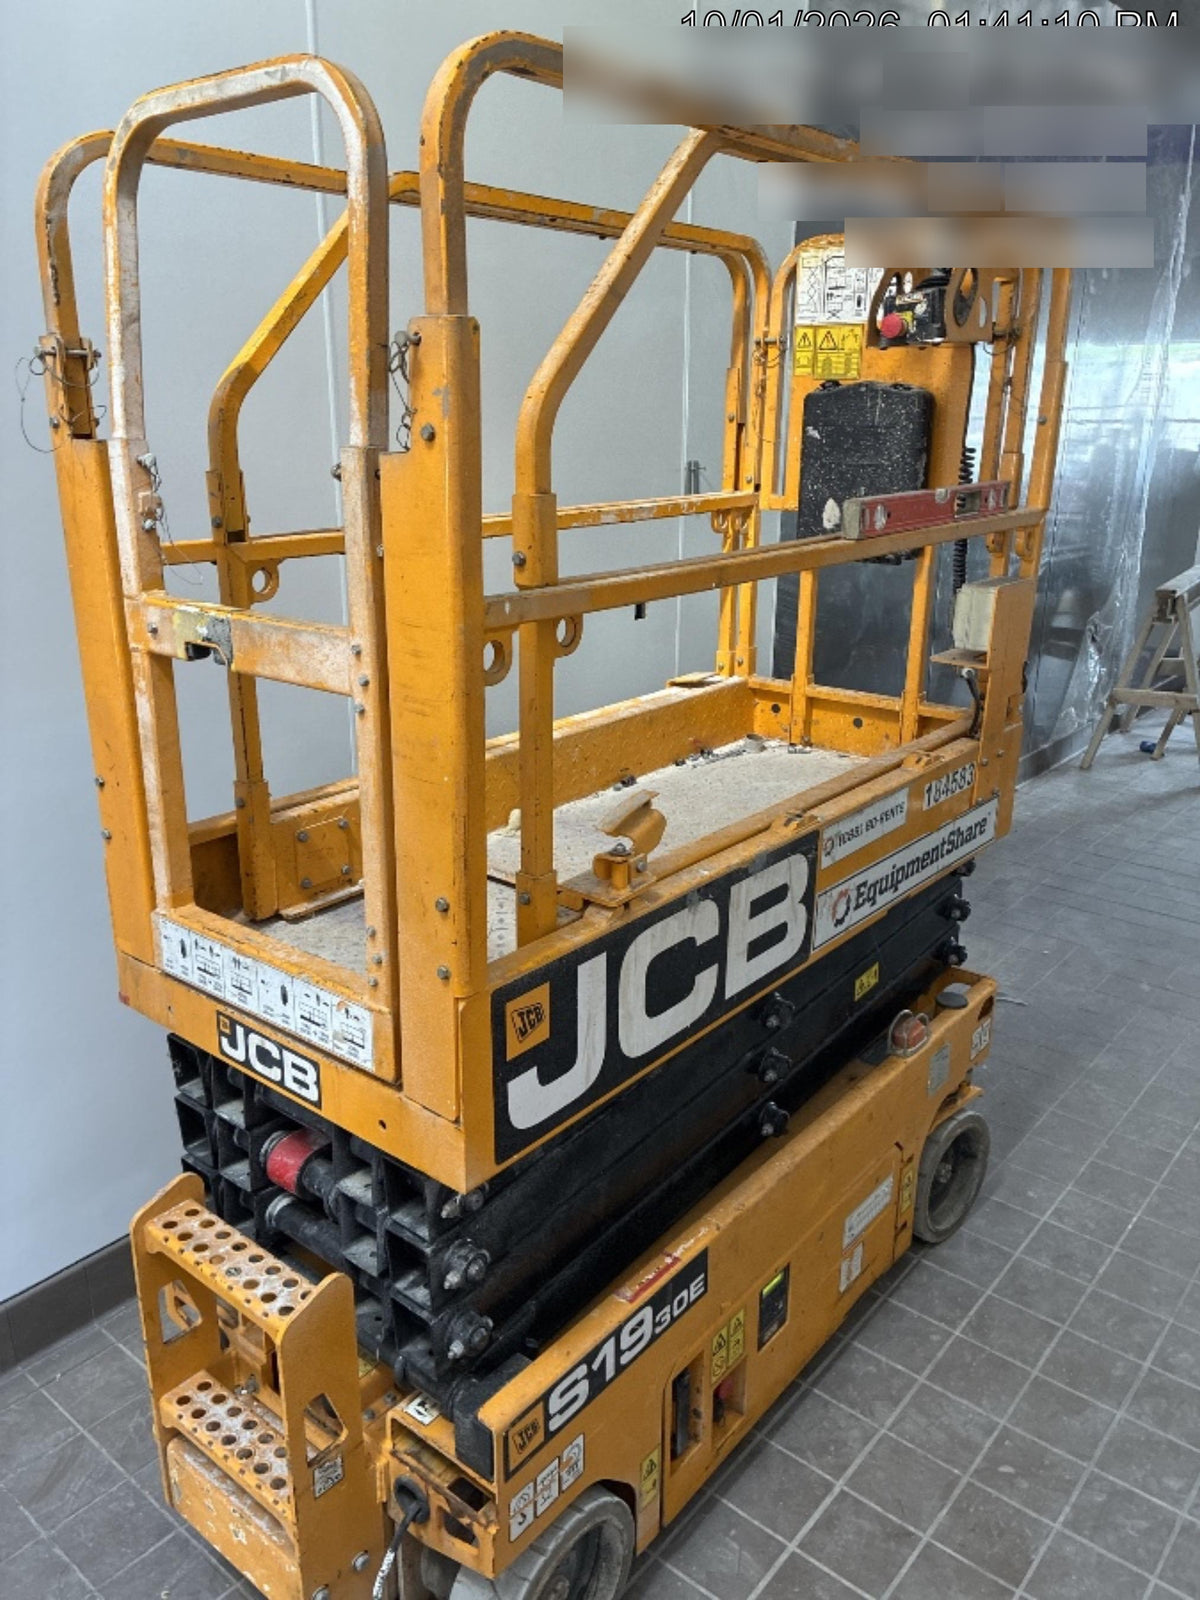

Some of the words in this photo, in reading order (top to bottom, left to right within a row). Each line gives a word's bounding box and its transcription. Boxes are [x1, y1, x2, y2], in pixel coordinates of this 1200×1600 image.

[852, 816, 988, 911] EquipmentShare
[507, 853, 809, 1129] JCB
[514, 1004, 544, 1040] JCB
[220, 1025, 319, 1102] JCB
